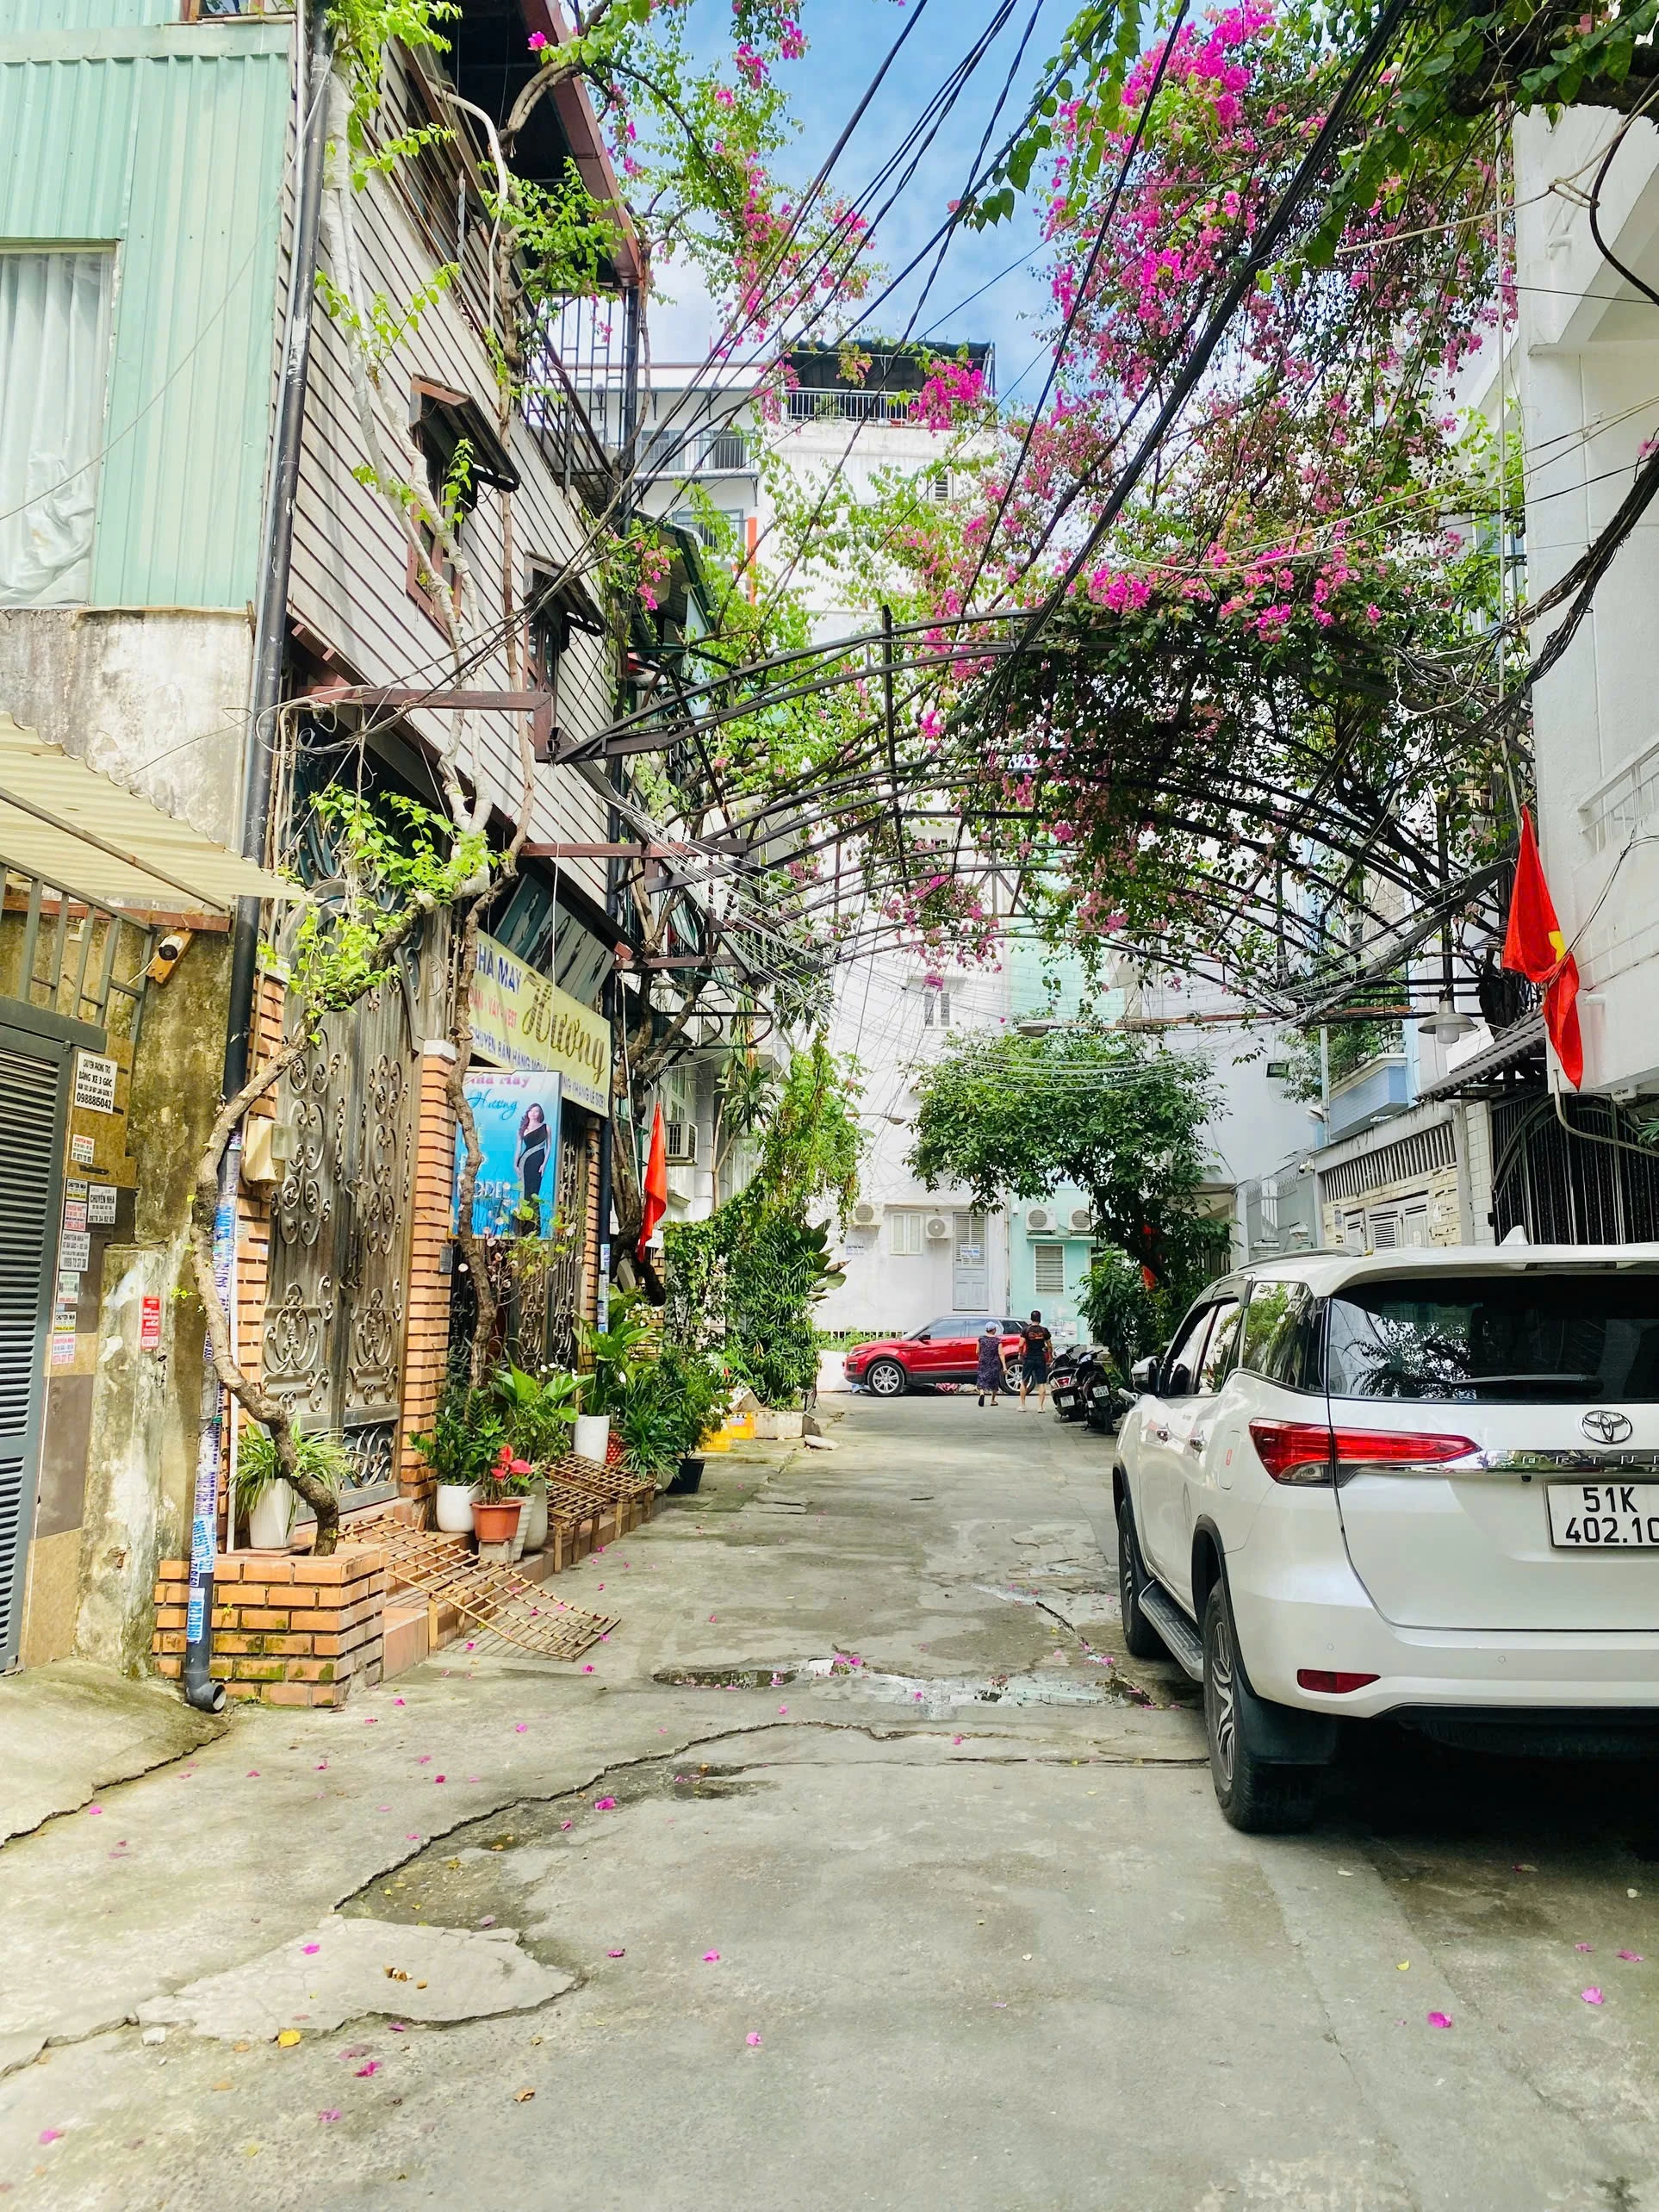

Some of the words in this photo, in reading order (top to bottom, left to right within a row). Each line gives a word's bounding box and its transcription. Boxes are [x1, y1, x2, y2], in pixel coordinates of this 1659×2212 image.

[475, 944, 494, 979] HÀ
[498, 956, 522, 995] MAY
[1582, 1487, 1638, 1513] 51K
